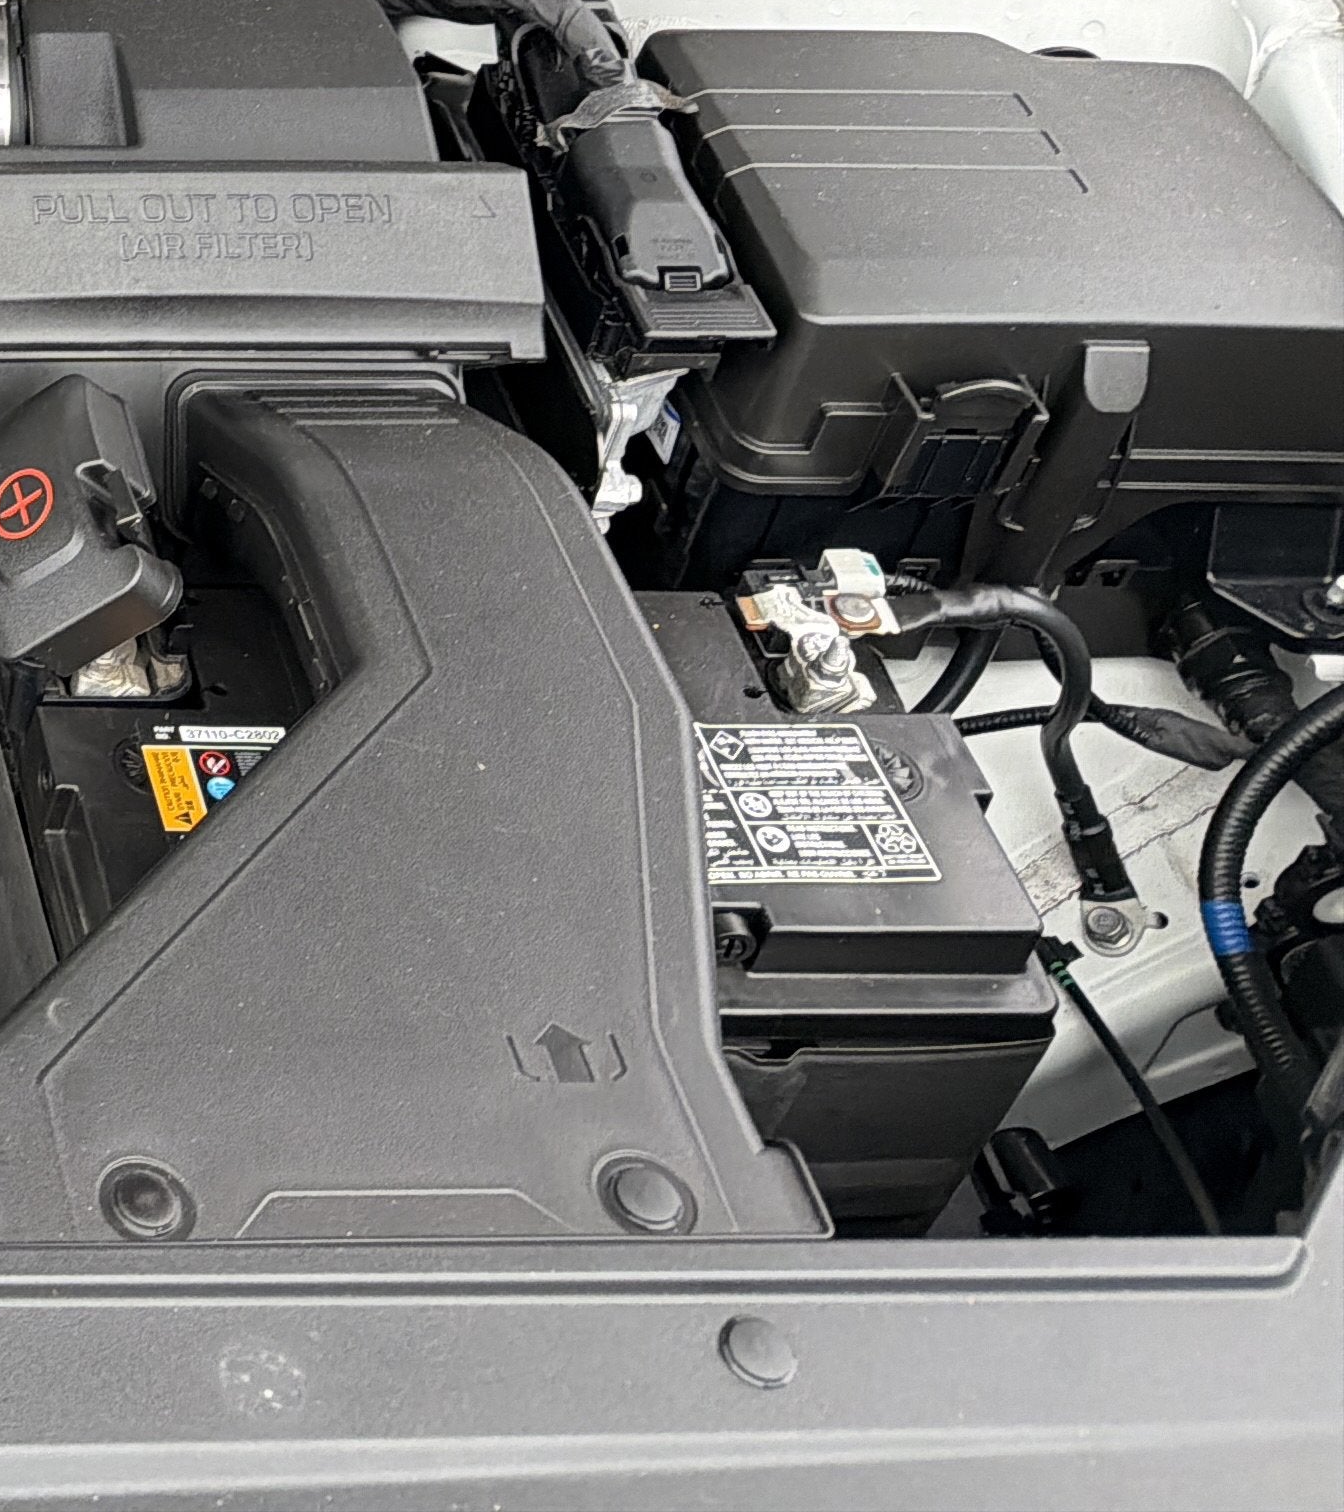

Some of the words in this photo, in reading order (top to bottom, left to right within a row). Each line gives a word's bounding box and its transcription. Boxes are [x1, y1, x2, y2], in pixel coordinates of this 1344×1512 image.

[32, 193, 129, 225] PULL
[140, 193, 216, 224] OUT
[226, 193, 278, 224] TO
[289, 193, 393, 224] OPEN
